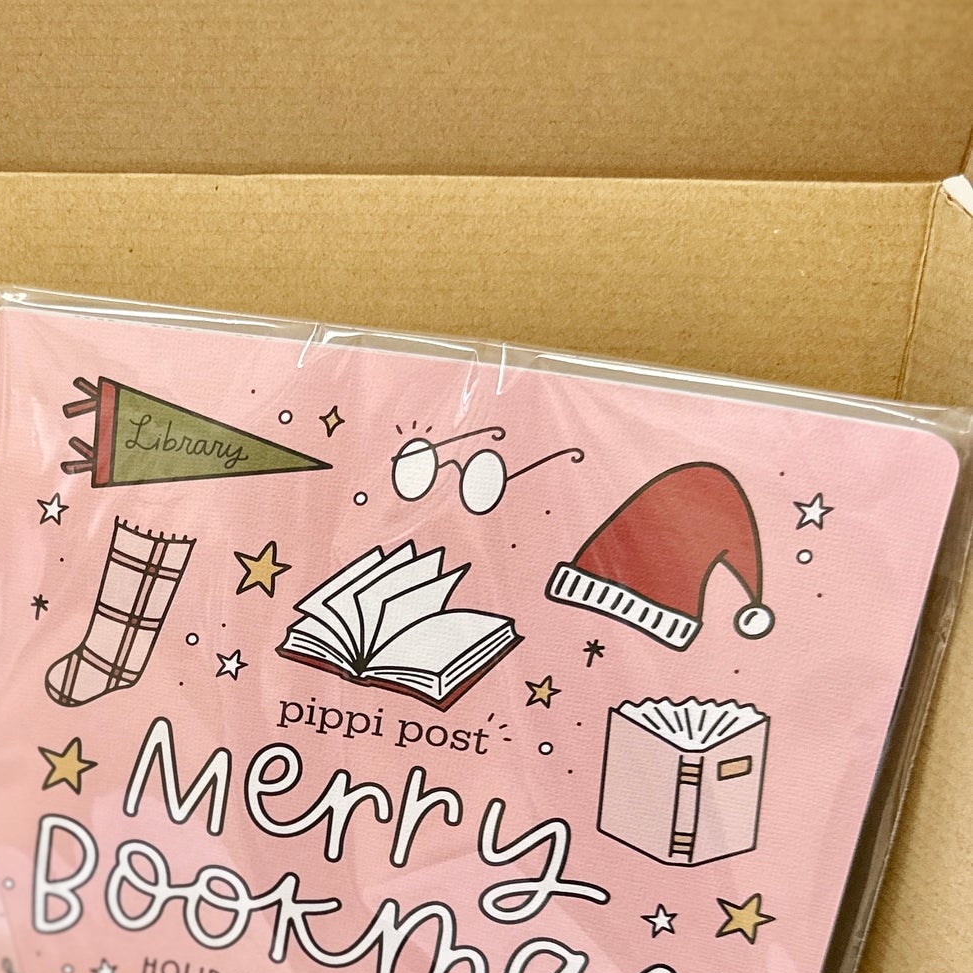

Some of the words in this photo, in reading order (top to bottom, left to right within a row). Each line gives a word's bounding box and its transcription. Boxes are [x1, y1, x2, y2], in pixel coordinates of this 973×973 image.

[125, 414, 249, 469] Library
[277, 697, 384, 740] pippi
[395, 719, 490, 755] post
[126, 716, 610, 923] Merry
